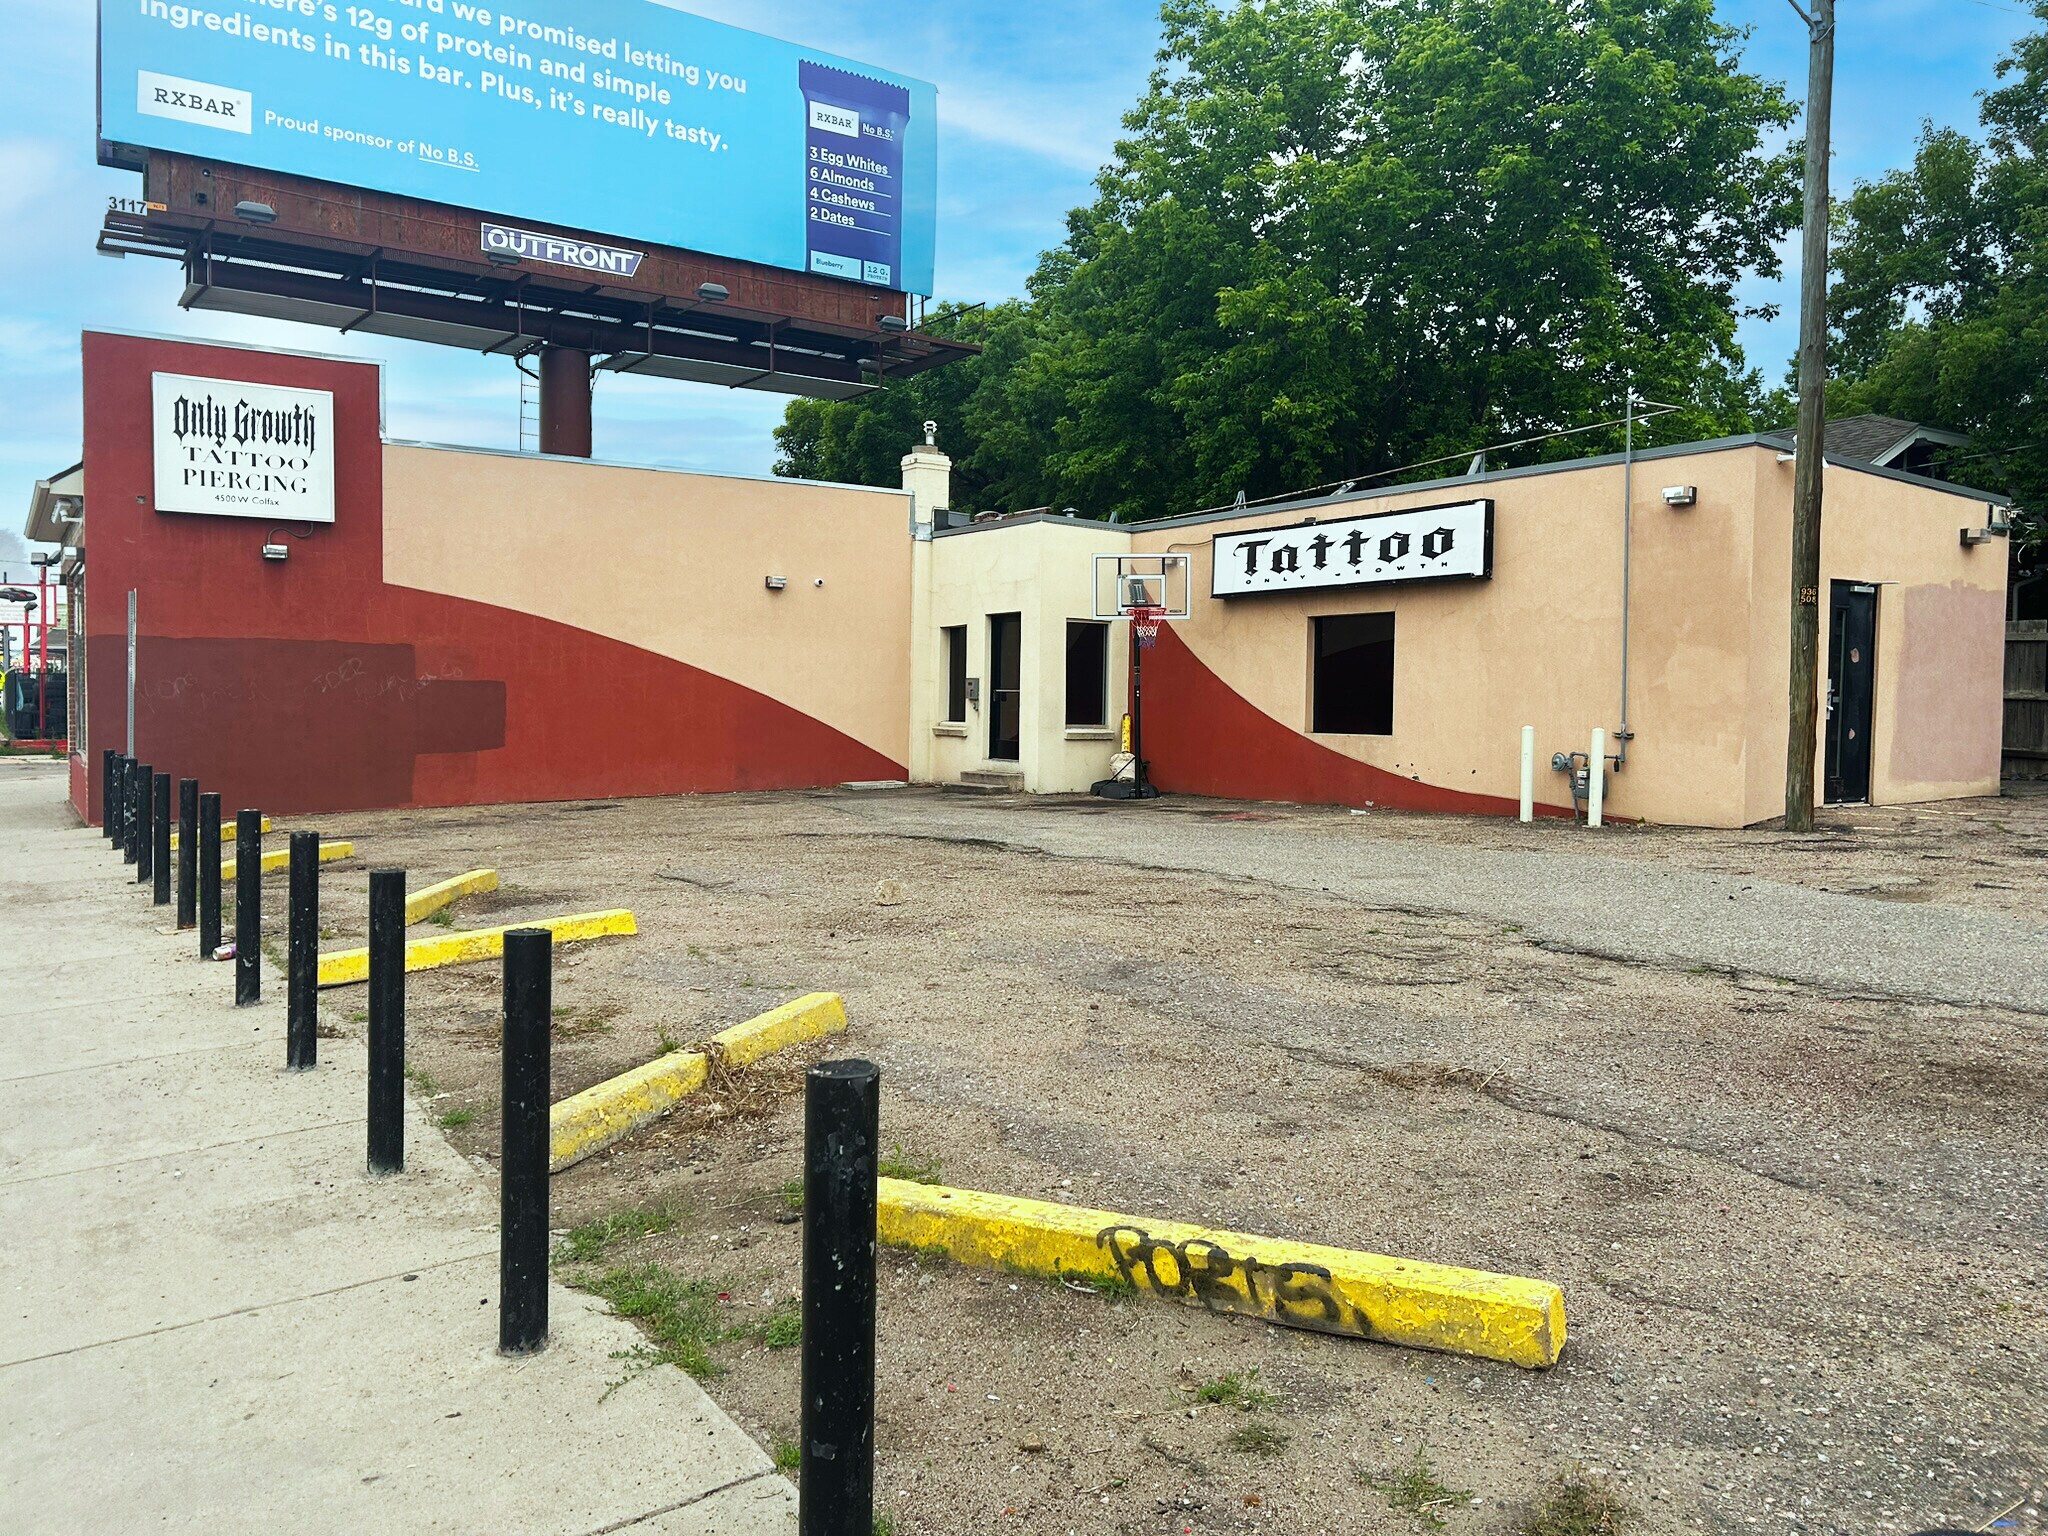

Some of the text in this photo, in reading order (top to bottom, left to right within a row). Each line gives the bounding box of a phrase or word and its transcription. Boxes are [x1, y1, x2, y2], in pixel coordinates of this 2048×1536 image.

[345, 6, 393, 41] 12g
[400, 21, 429, 44] of
[436, 31, 533, 71] protein
[540, 58, 586, 84] and
[592, 68, 671, 105] simple
[451, 1, 492, 26] we
[499, 14, 617, 60] promised
[624, 41, 700, 86] letting
[705, 69, 747, 94] you
[154, 87, 237, 118] RXBAR
[324, 32, 351, 61] in
[358, 43, 411, 75] this
[419, 55, 473, 89] bar.
[481, 70, 542, 110] Plus,
[550, 87, 586, 116] it's
[592, 103, 660, 138] really
[664, 118, 729, 153] tasty.
[816, 112, 853, 129] RXBAR
[862, 123, 876, 134] No
[264, 110, 480, 168] Proud sponsor of No B.S.
[809, 146, 889, 176] 3 Egg Whites
[809, 166, 875, 191] 6 Almonds
[108, 196, 148, 215] 3117
[809, 187, 876, 211] 4 Cashews
[810, 207, 855, 226] 2 Dates
[487, 228, 635, 273] OUTFRONT
[815, 257, 844, 270] Blueberry
[867, 265, 878, 274] 12
[173, 393, 316, 459] Only Growth
[182, 446, 309, 472] TATTOO
[183, 468, 307, 494] PIERCING
[214, 494, 236, 503] 4500
[251, 496, 280, 506] Colfax
[1232, 526, 1456, 577] Tattoo
[1245, 574, 1305, 585] ONLY
